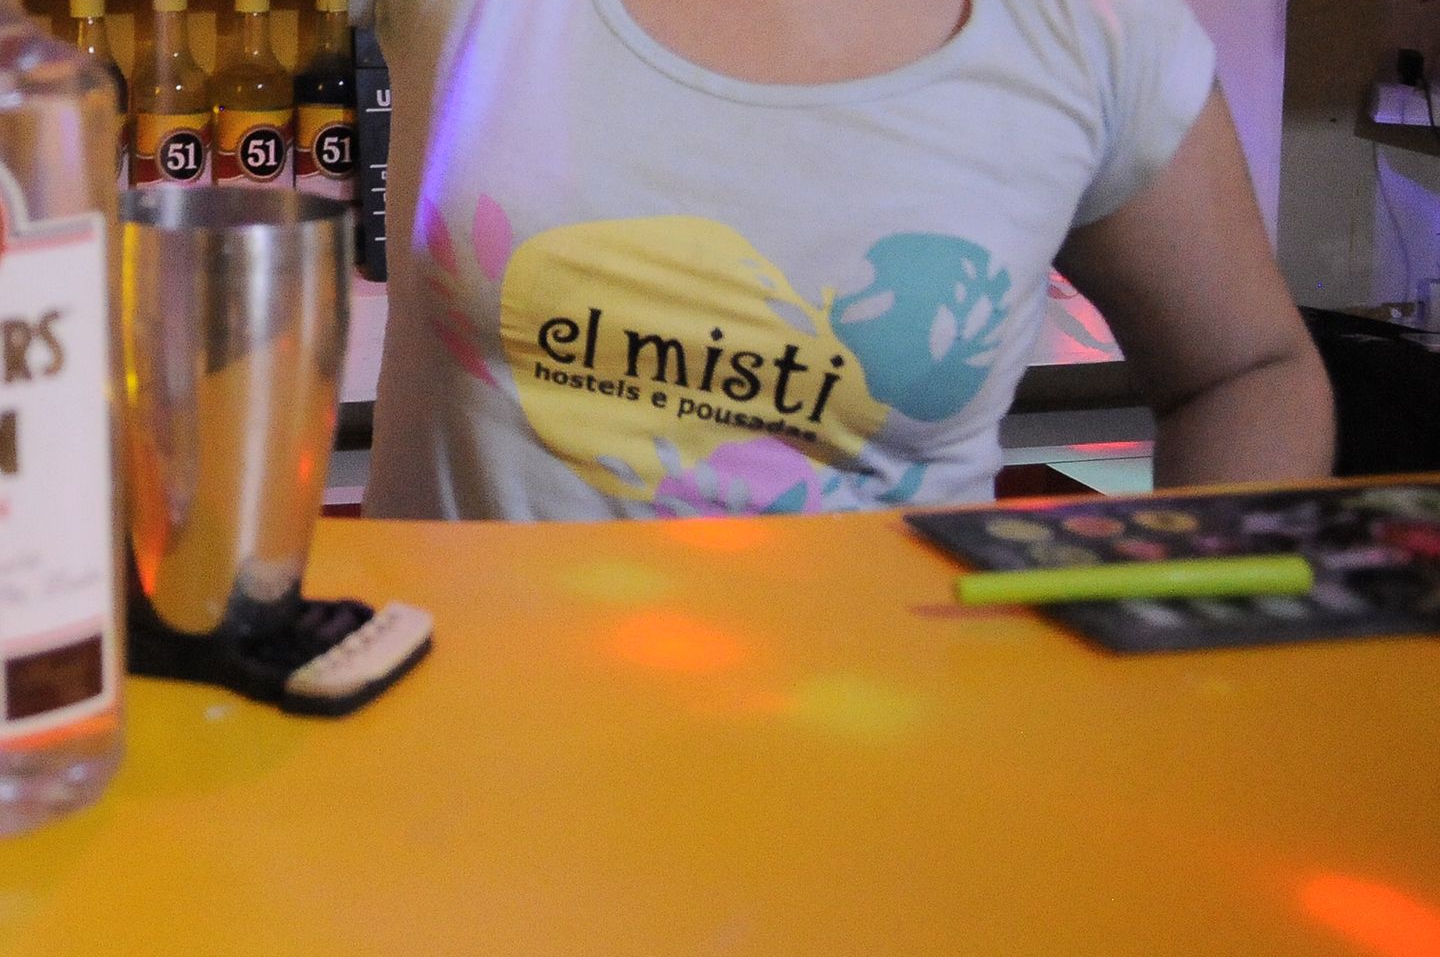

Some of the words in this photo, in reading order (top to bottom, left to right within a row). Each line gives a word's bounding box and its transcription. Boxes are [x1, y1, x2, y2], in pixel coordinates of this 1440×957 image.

[167, 144, 197, 171] 51
[247, 138, 278, 167] 51
[322, 137, 353, 163] 51
[537, 306, 602, 369] el
[623, 326, 846, 423] misti
[534, 361, 641, 402] hostels
[650, 389, 668, 410] e
